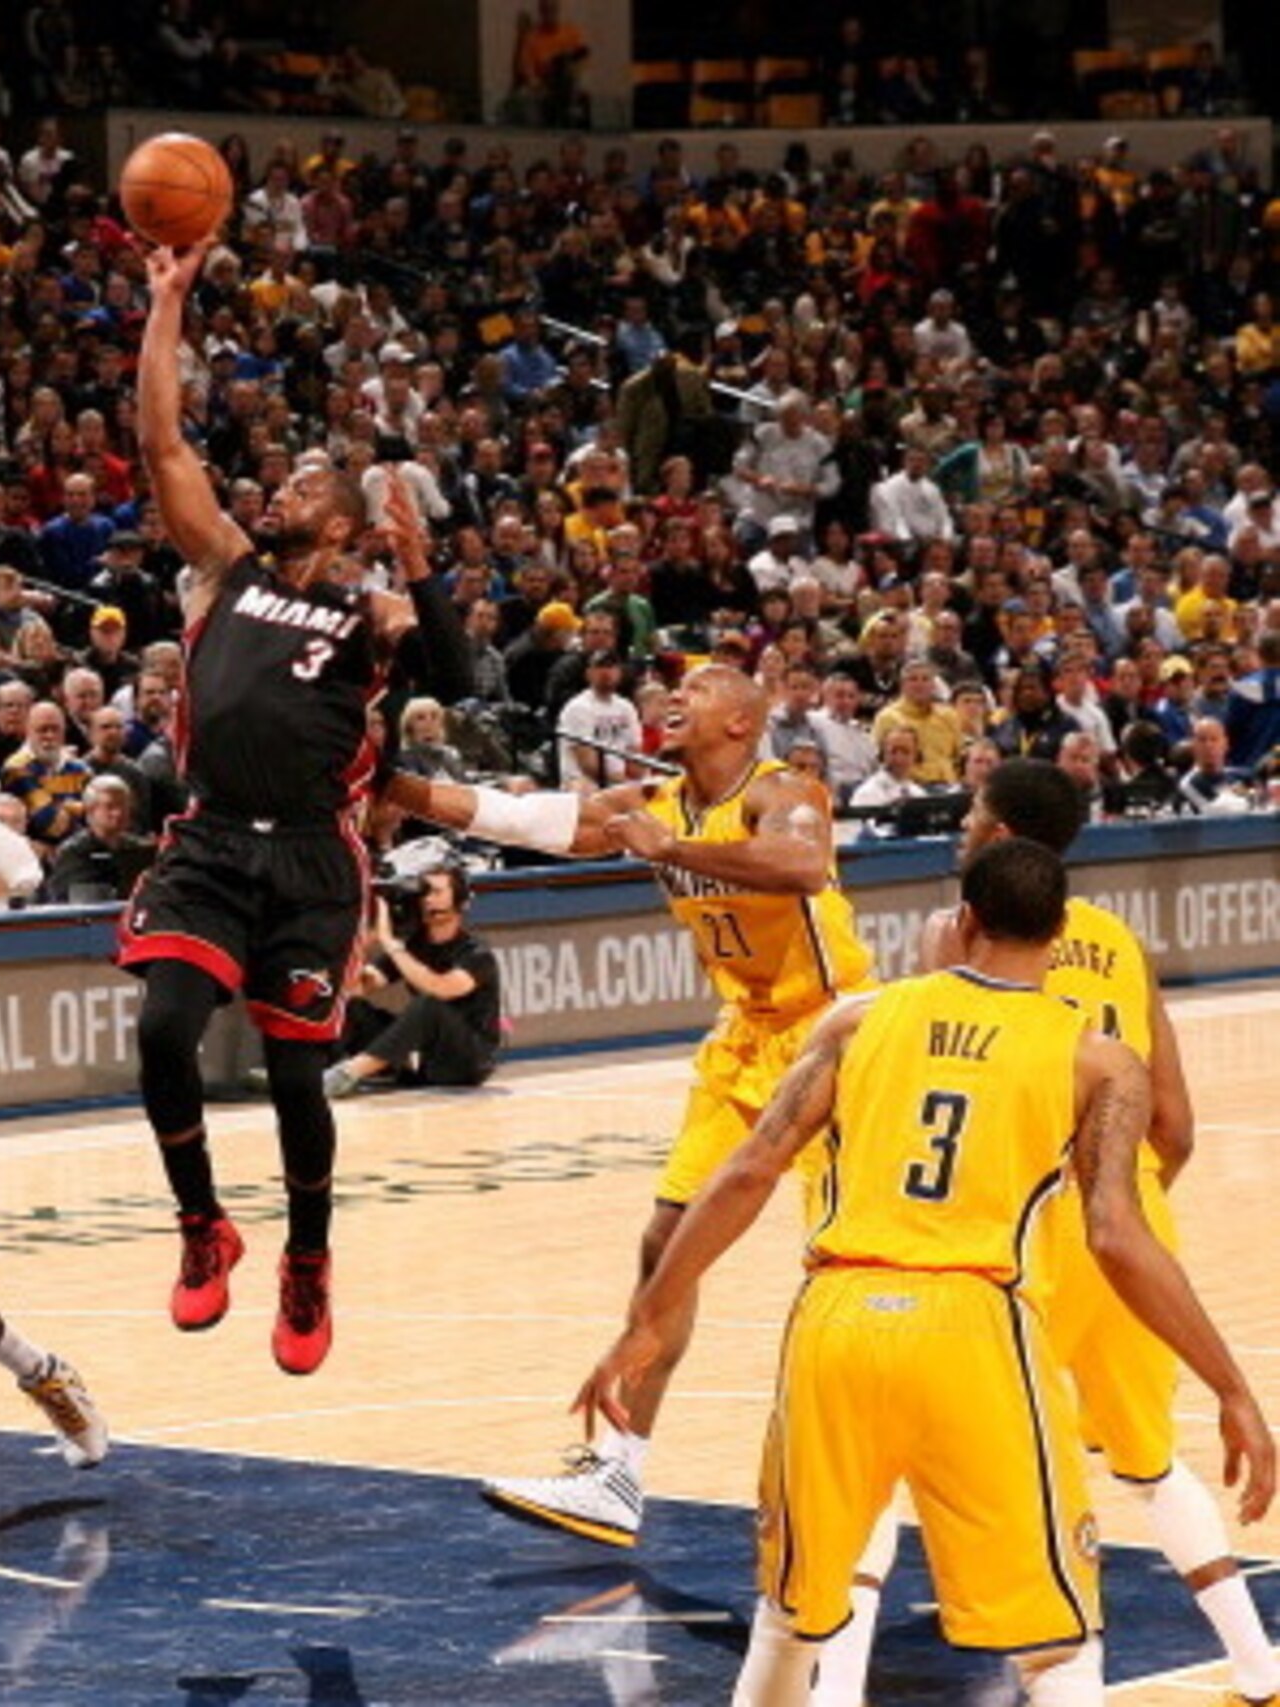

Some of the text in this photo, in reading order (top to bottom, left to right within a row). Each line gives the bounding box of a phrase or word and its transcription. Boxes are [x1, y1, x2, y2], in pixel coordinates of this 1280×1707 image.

[233, 584, 362, 639] MIAMI
[291, 638, 334, 681] 3
[701, 911, 753, 958] 21
[1174, 878, 1280, 951] OFFER
[491, 930, 713, 1018] NBA.COM
[49, 981, 148, 1067] OFF
[929, 1020, 1001, 1062] HILL
[903, 1091, 968, 1200] 3
